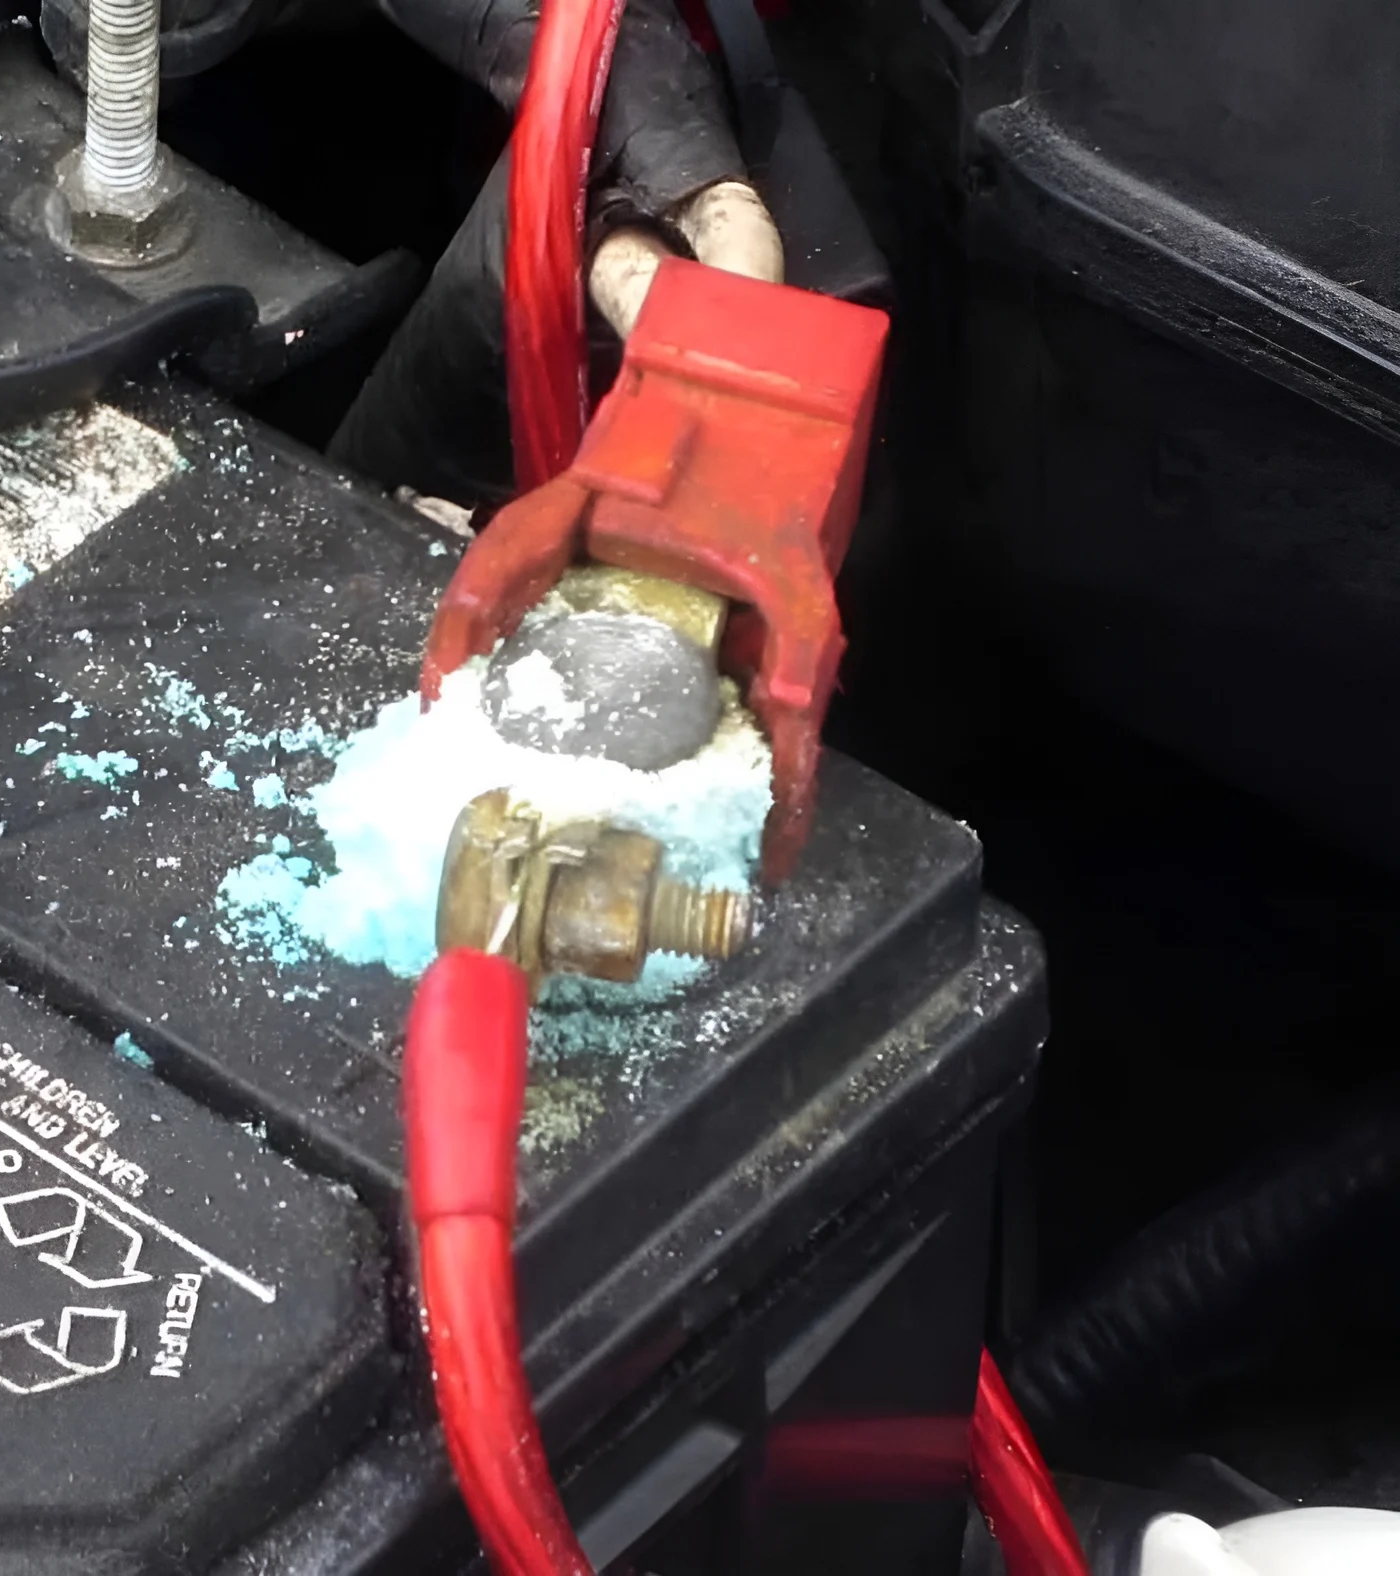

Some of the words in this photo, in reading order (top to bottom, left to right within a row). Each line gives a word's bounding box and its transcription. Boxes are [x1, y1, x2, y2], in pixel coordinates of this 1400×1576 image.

[0, 1094, 67, 1140] AND
[62, 1131, 150, 1198] LEVEL
[148, 1272, 202, 1379] RETURN
